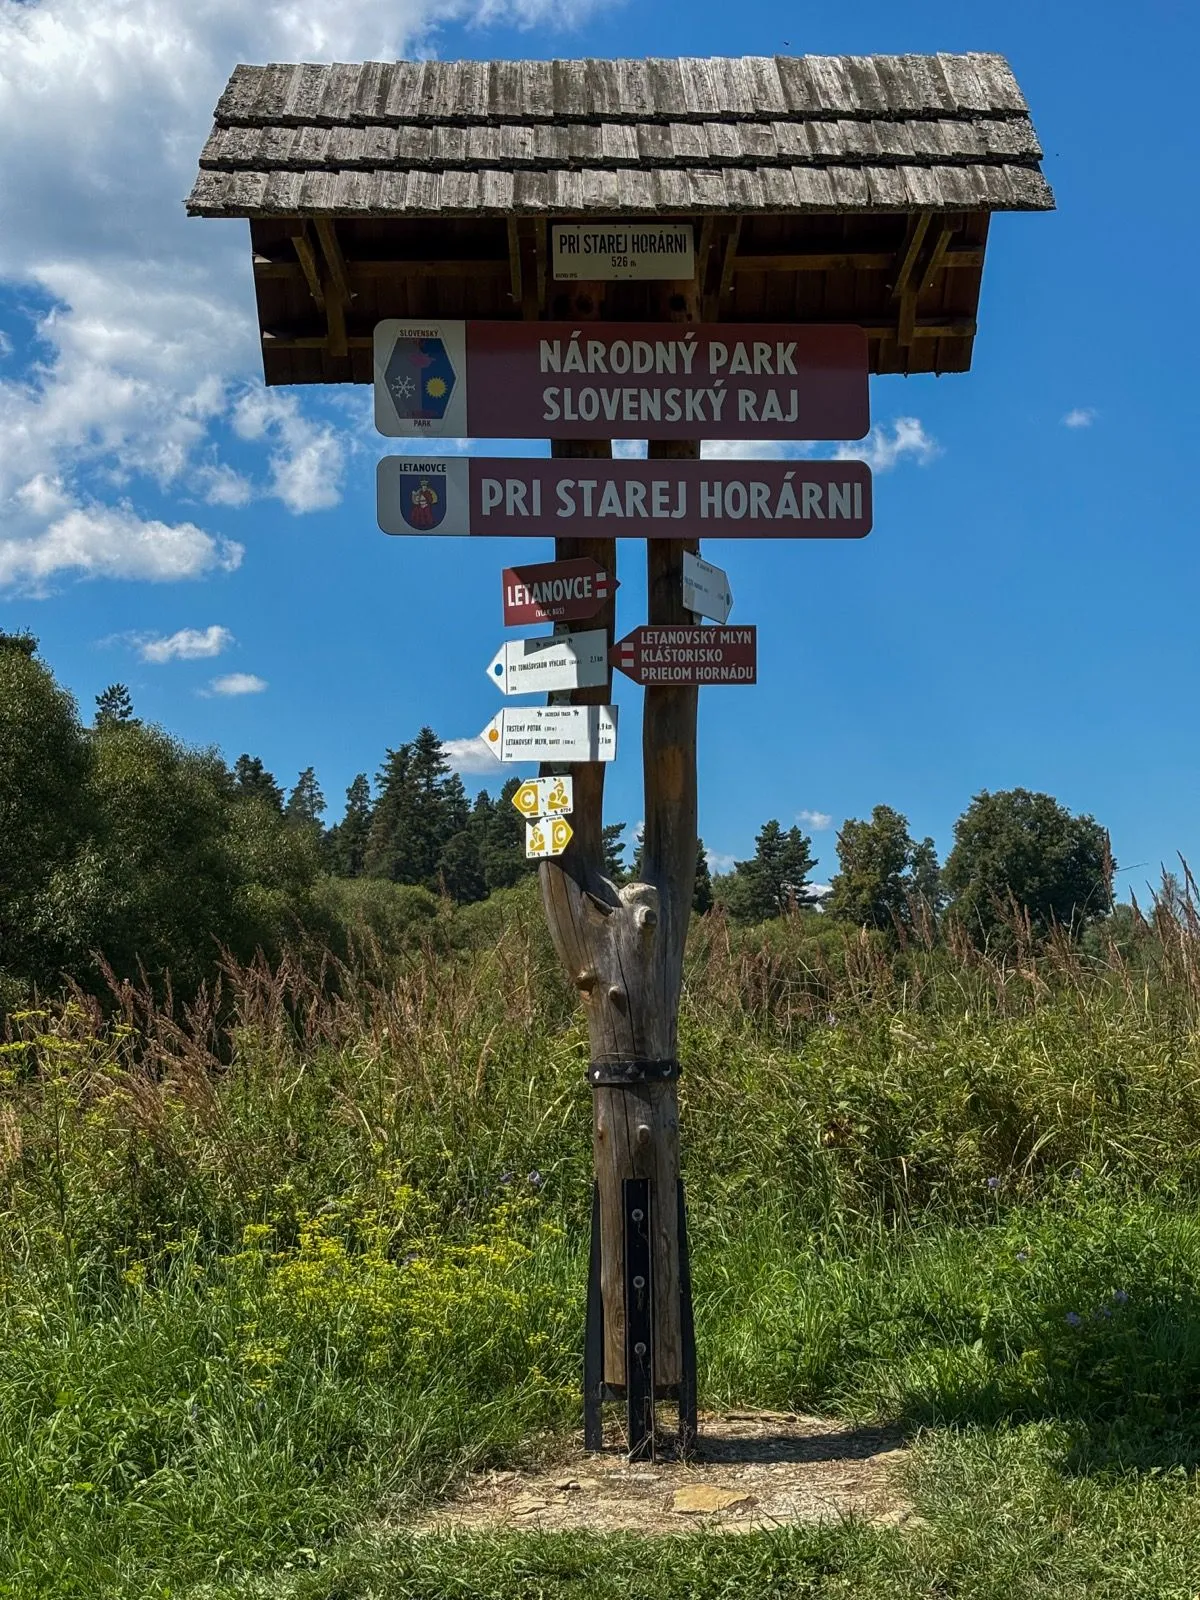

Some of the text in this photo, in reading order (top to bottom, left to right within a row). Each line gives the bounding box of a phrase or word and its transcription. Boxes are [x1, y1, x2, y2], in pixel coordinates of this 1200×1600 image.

[560, 230, 686, 254] PRI STAREJ HORÁRNI
[612, 256, 628, 267] 526
[540, 330, 798, 374] NÁRODNÝ PARK
[542, 380, 798, 422] SLOVENSKÝ RAJ
[400, 464, 446, 472] LETANOVCE
[481, 472, 862, 520] PRI STAREJ HORÁRNI
[508, 576, 592, 606] LETANOVCE
[640, 628, 752, 644] LETANOVSKÝ MLYN
[640, 646, 722, 662] KLÁŠTORISKO
[641, 663, 753, 680] PRIELOM HORNÁDU
[506, 737, 533, 746] LETANOVSKÝ
